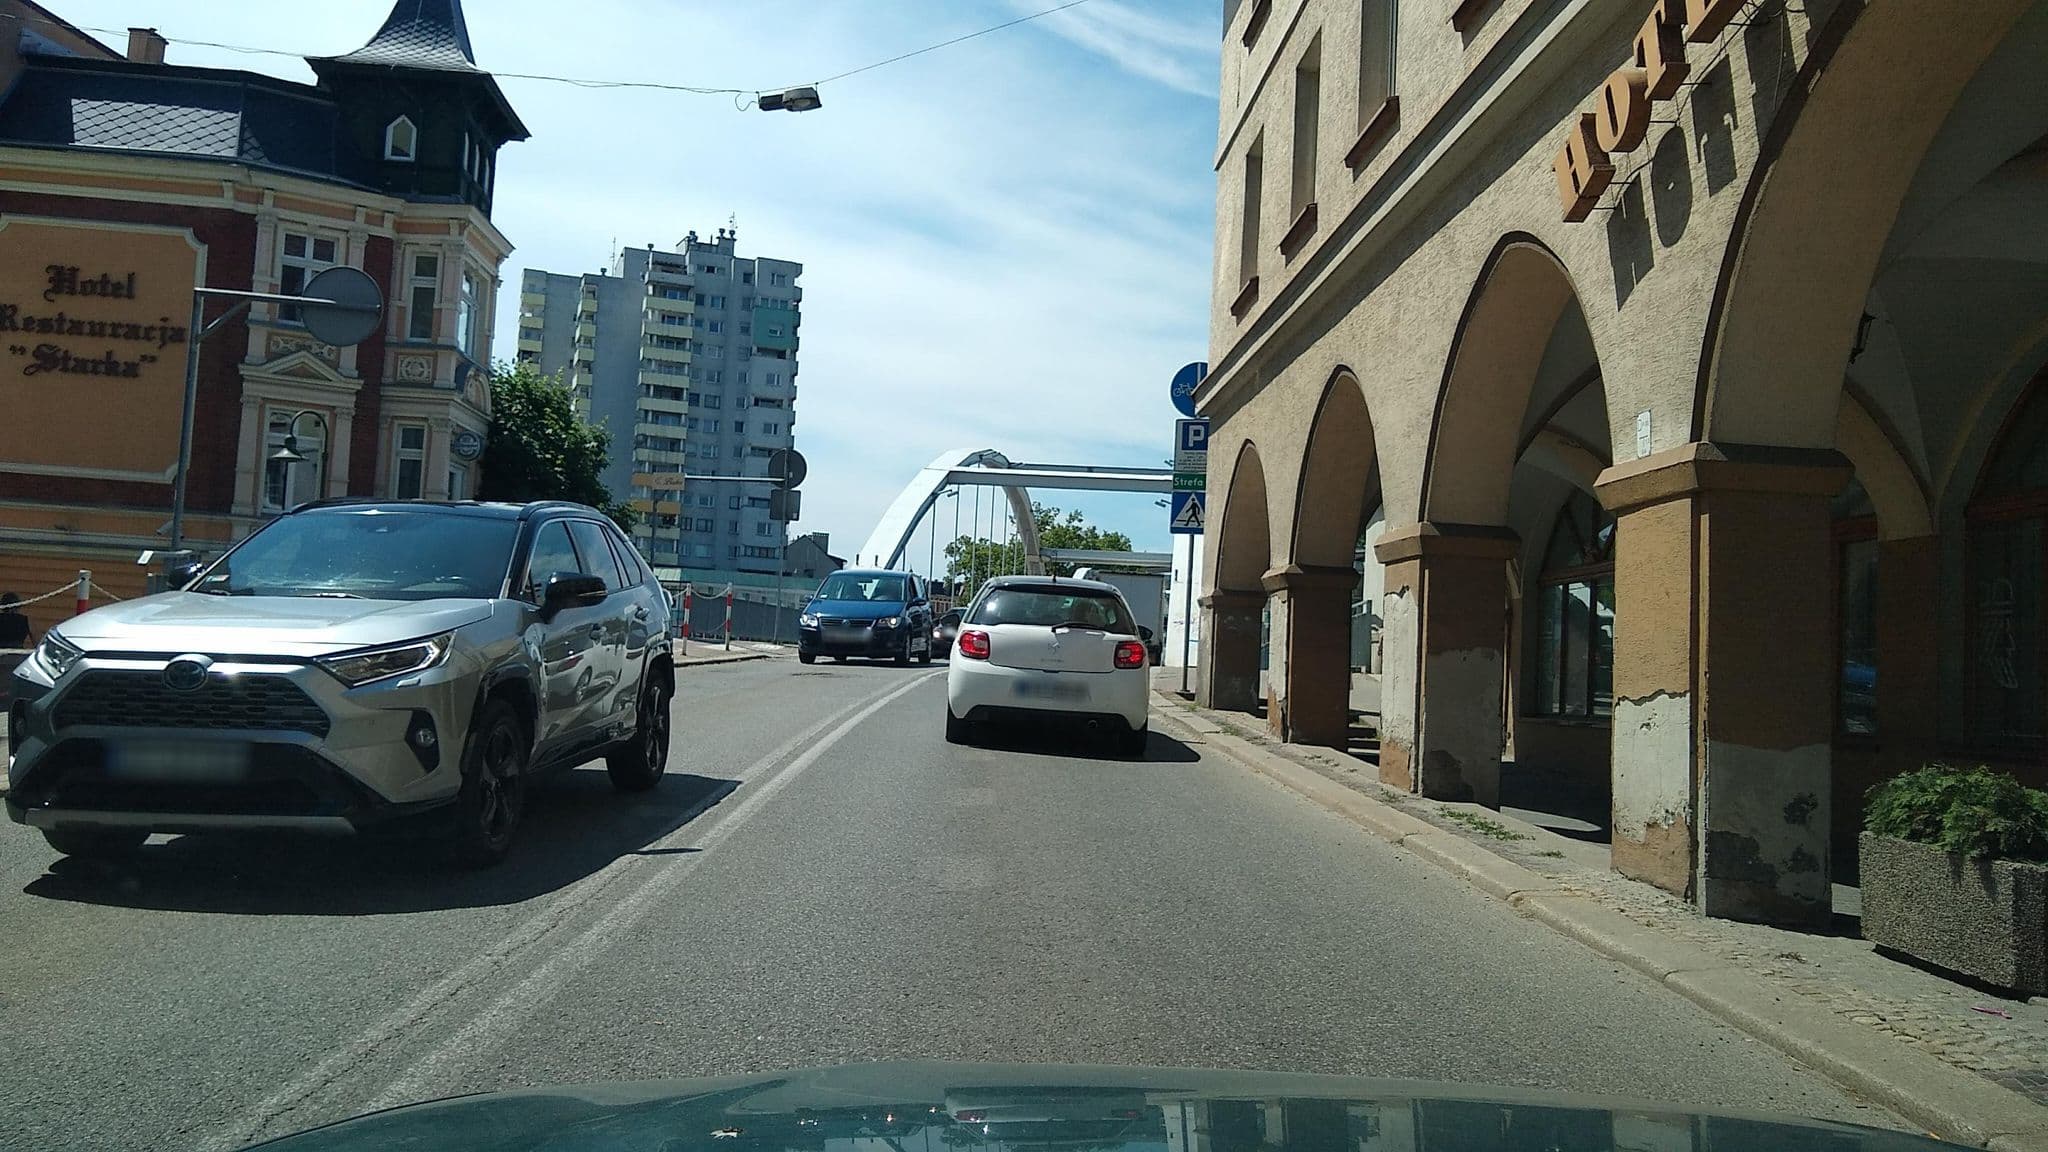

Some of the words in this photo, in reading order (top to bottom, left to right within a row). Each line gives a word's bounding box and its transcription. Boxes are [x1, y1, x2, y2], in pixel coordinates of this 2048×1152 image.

[43, 264, 136, 302] Hotel
[0, 303, 187, 349] Restauracja
[1188, 425, 1205, 447] P
[1174, 476, 1204, 487] Strefa
